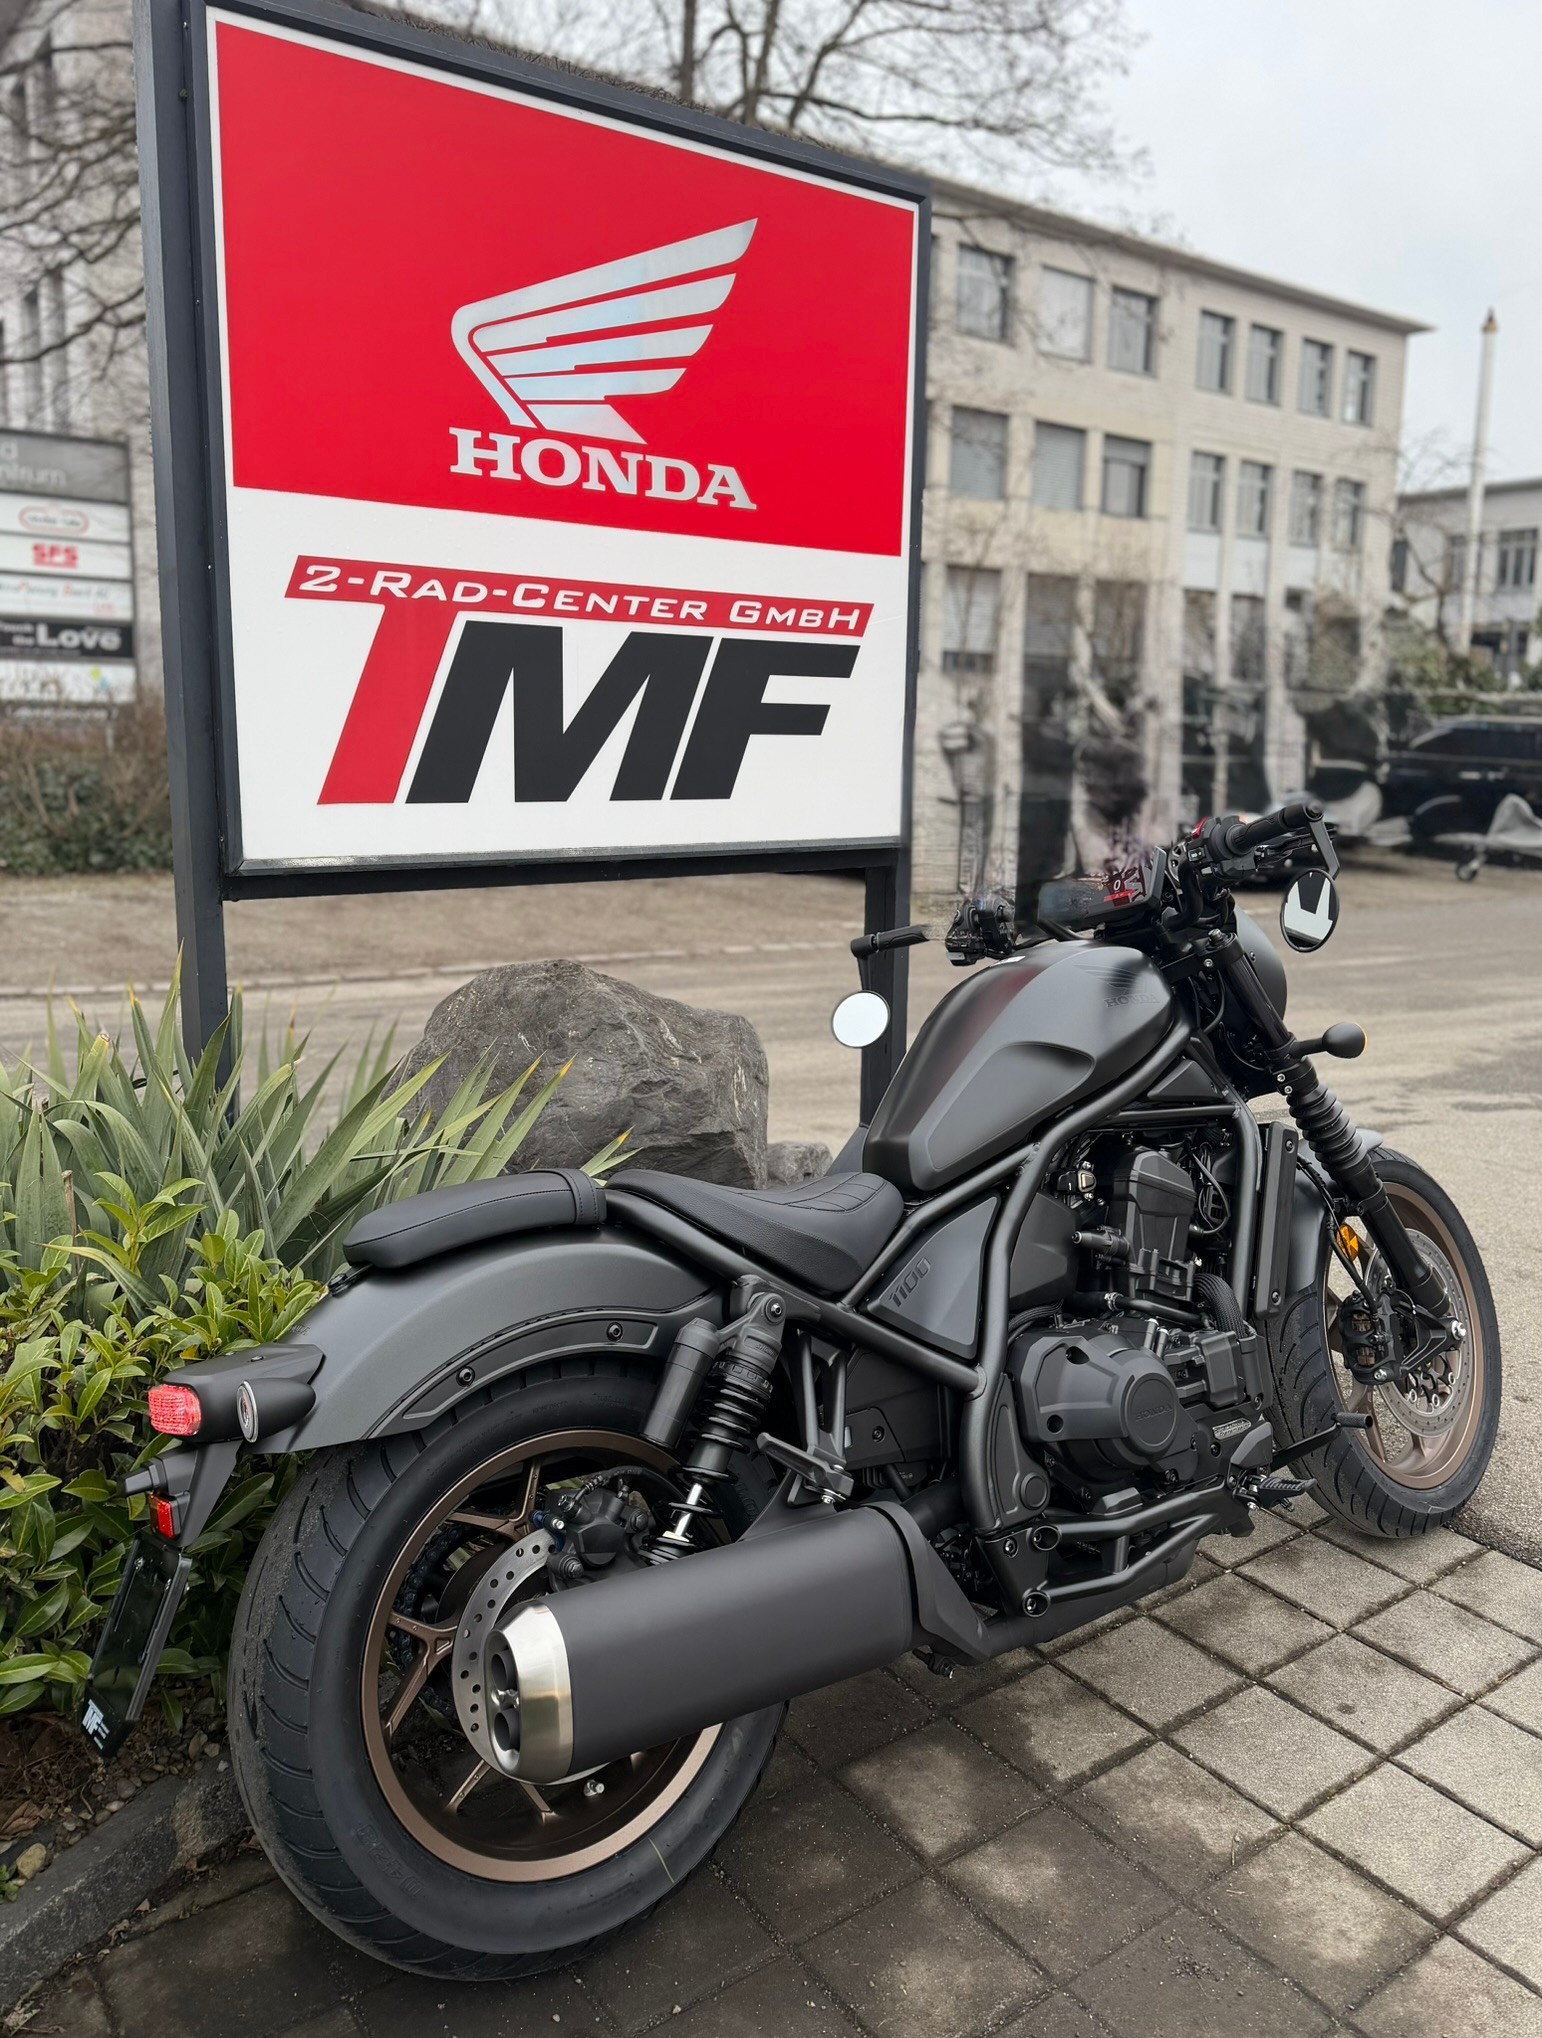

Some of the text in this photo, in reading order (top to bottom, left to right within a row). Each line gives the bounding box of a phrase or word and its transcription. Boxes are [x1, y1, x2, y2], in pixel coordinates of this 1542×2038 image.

[449, 427, 757, 511] HONDA
[36, 622, 122, 652] Love
[285, 555, 874, 806] TMF
[1104, 992, 1161, 1008] HONDA
[889, 1257, 931, 1308] 1100
